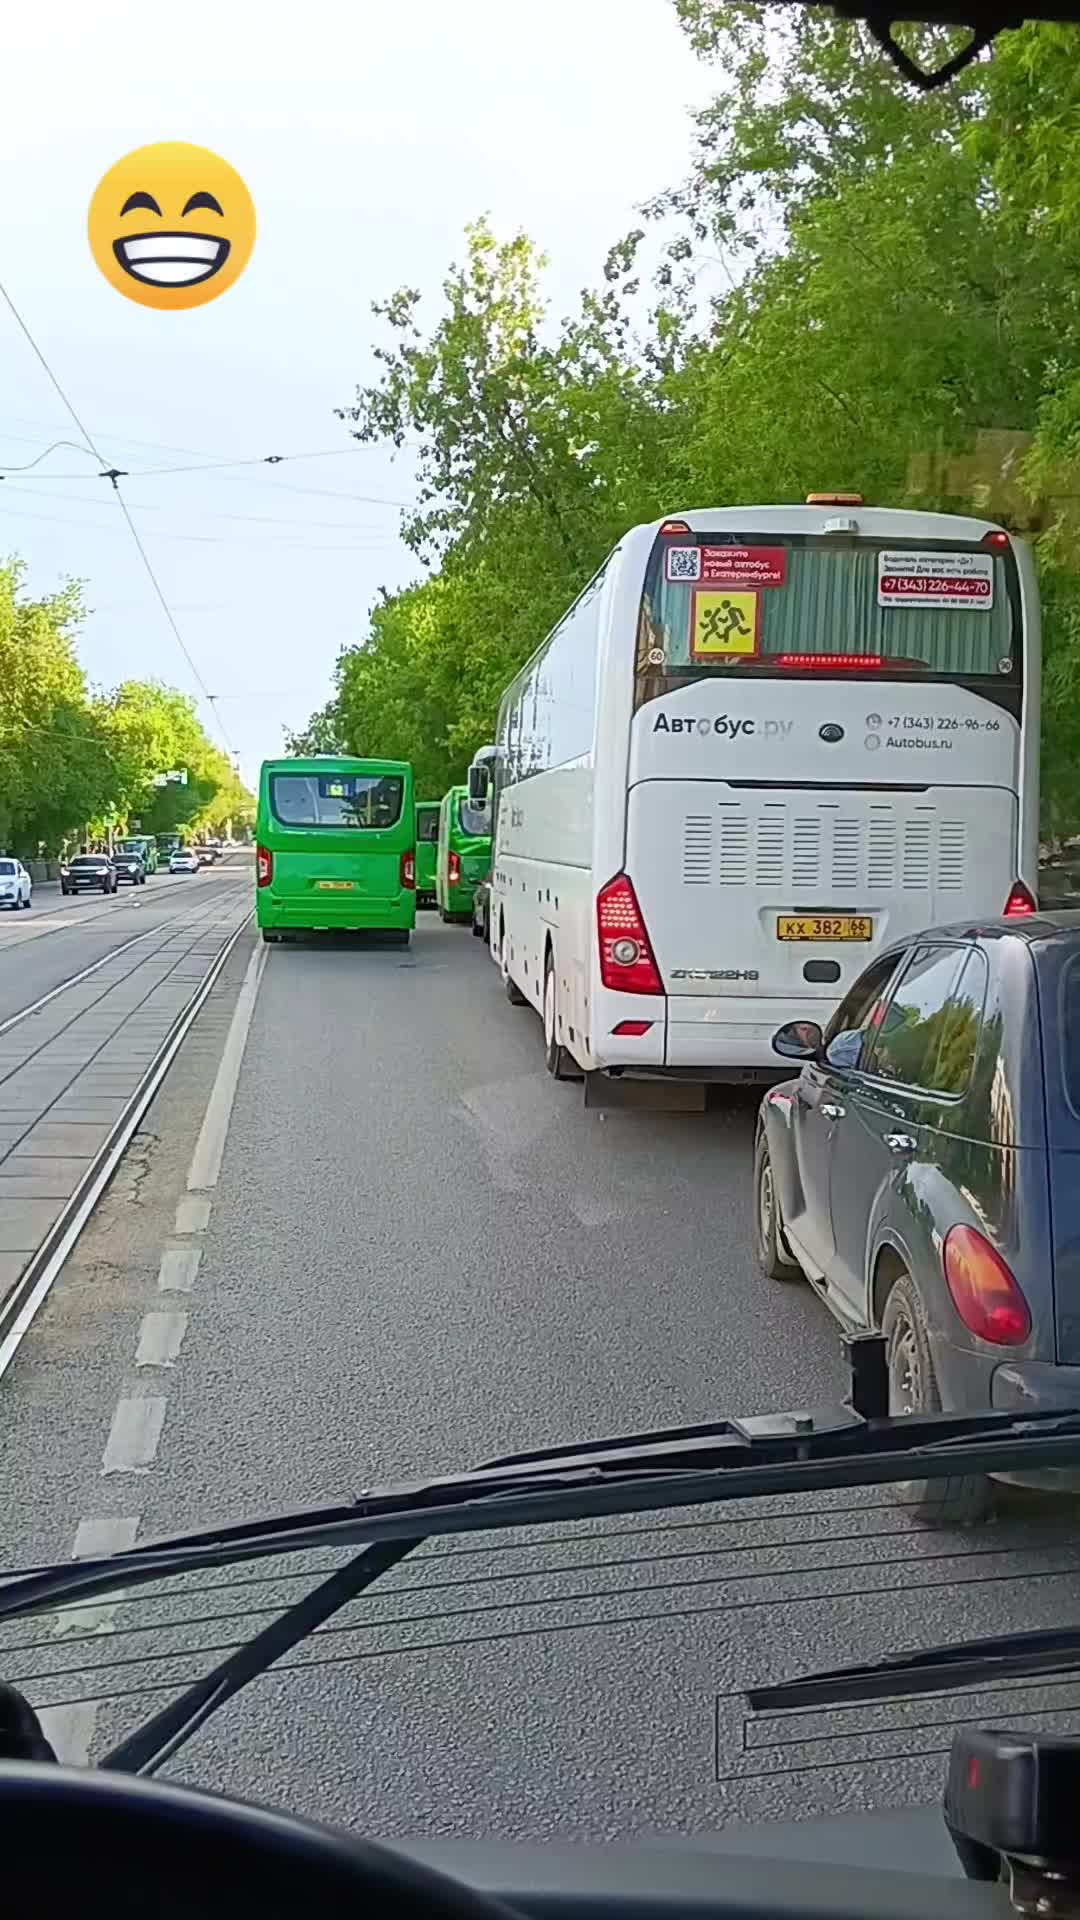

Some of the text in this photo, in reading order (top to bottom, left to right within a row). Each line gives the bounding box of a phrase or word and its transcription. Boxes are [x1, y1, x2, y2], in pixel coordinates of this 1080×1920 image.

[734, 561, 770, 570] автобус
[884, 578, 988, 593] +7 (343) 226-44-70
[888, 716, 1000, 731] +7 (343) 226-96-66
[886, 737, 953, 749] Autobus.ru
[813, 919, 842, 935] 382
[850, 919, 865, 931] 66
